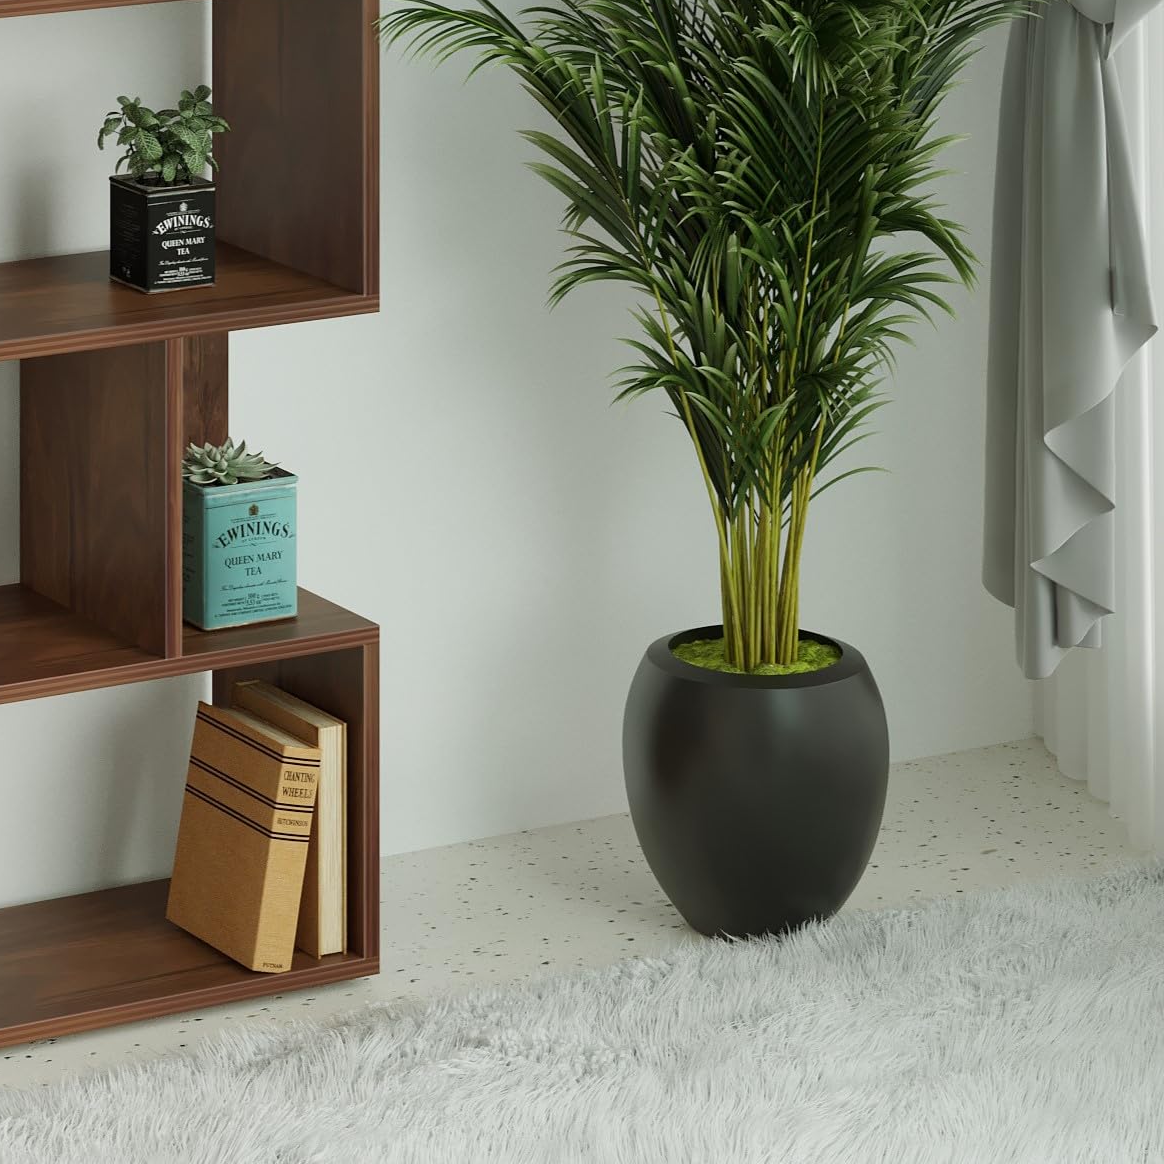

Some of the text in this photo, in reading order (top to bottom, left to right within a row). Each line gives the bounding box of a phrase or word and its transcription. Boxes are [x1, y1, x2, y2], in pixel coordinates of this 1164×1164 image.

[161, 236, 205, 249] QUEEN MARY
[224, 550, 283, 569] QUEEN MARY
[245, 566, 262, 577] TEA
